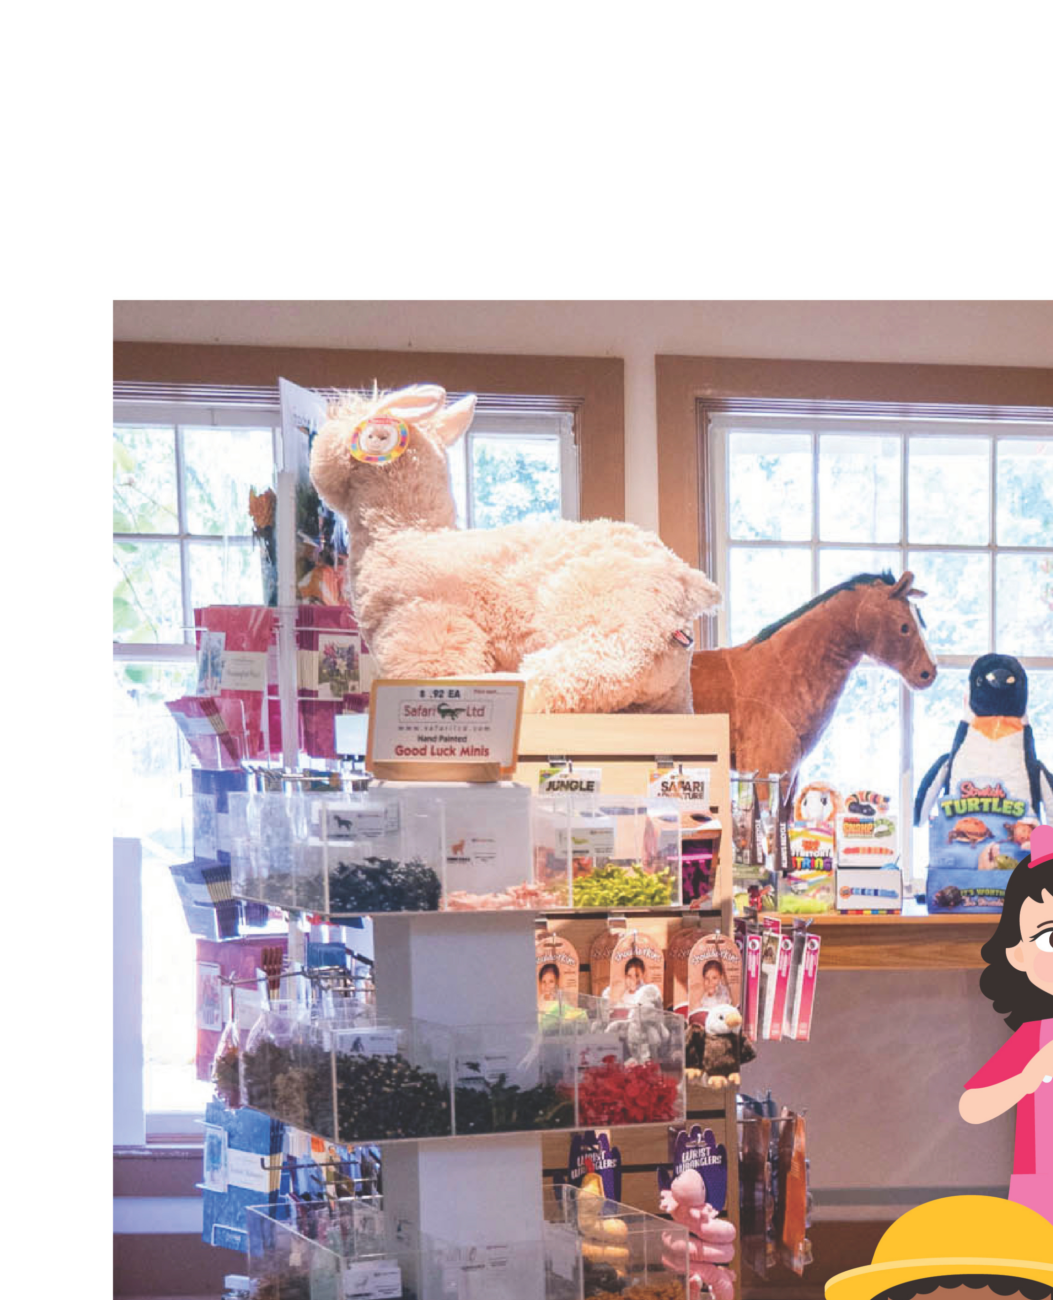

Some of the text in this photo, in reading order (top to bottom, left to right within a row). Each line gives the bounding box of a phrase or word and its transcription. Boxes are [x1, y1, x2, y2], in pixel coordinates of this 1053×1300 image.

[448, 689, 461, 698] EA
[404, 704, 486, 718] Safari Ltd
[439, 735, 468, 743] Painted
[395, 745, 490, 757] Good Luck Minis
[546, 780, 595, 793] JUNGLE
[661, 780, 705, 791] SAFARI
[941, 796, 1026, 819] TURTLES
[682, 1147, 711, 1163] WRIST
